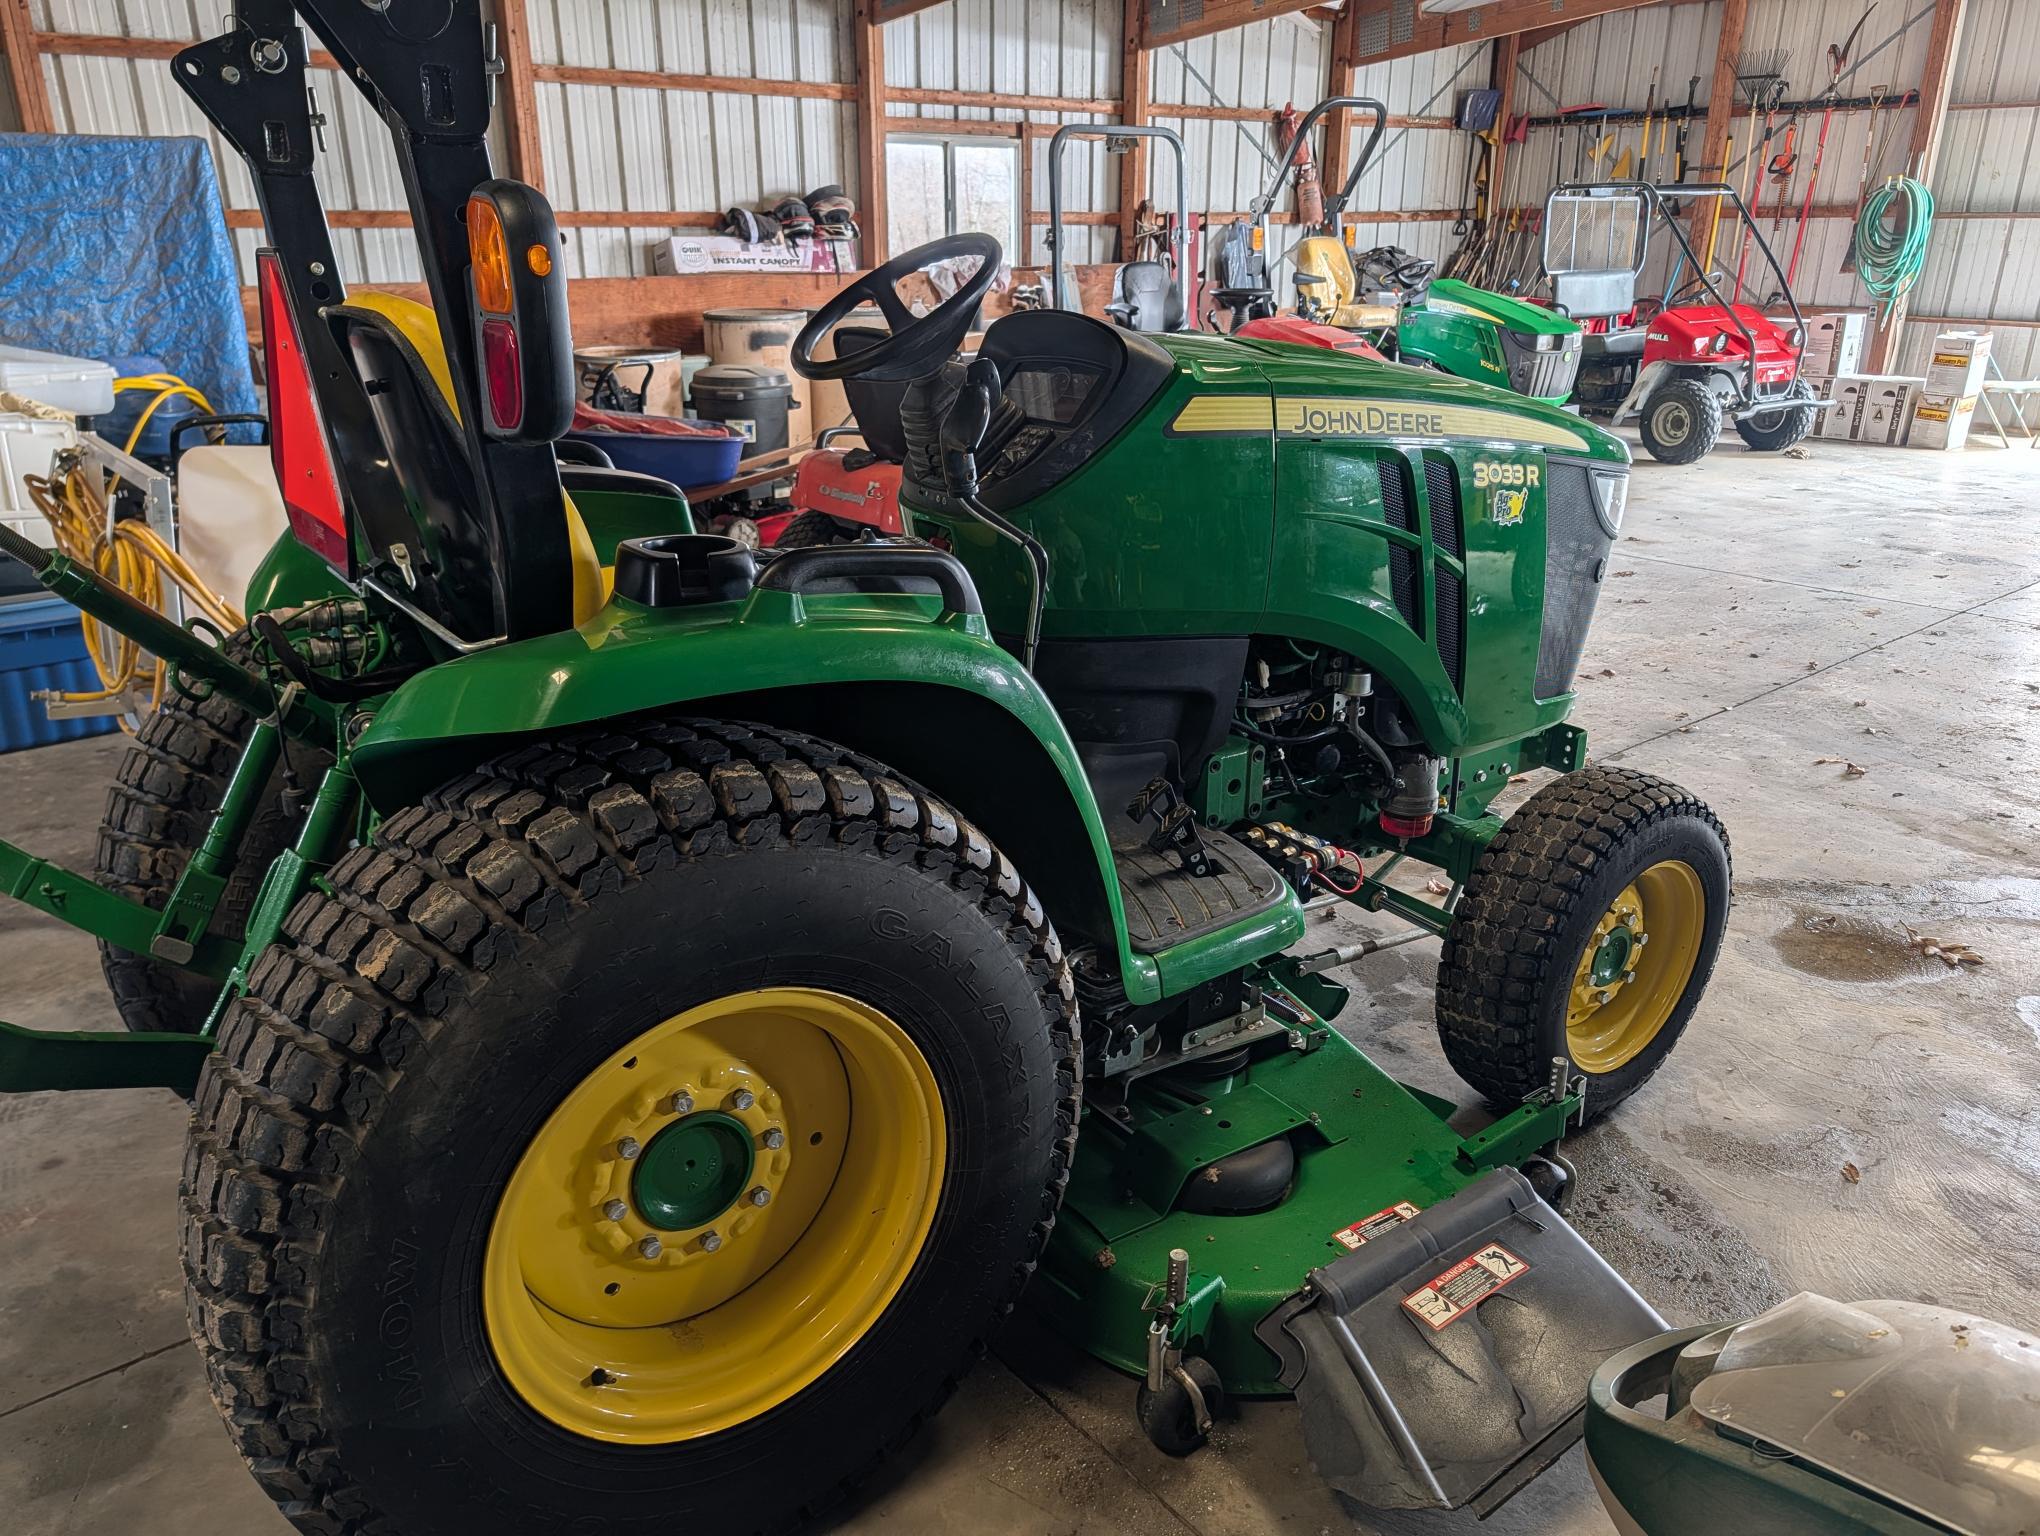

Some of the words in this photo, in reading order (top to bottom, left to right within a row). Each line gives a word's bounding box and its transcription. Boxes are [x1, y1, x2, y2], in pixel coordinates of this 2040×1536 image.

[712, 257, 757, 265] INSTANT
[760, 258, 801, 266] CANOPY
[1647, 334, 1669, 342] MULE
[1294, 405, 1365, 432] JOHN
[1366, 407, 1443, 434] DEERE
[869, 905, 1034, 1137] GALAXY
[1441, 1261, 1471, 1282] DANGER
[379, 1238, 426, 1411] MOW
